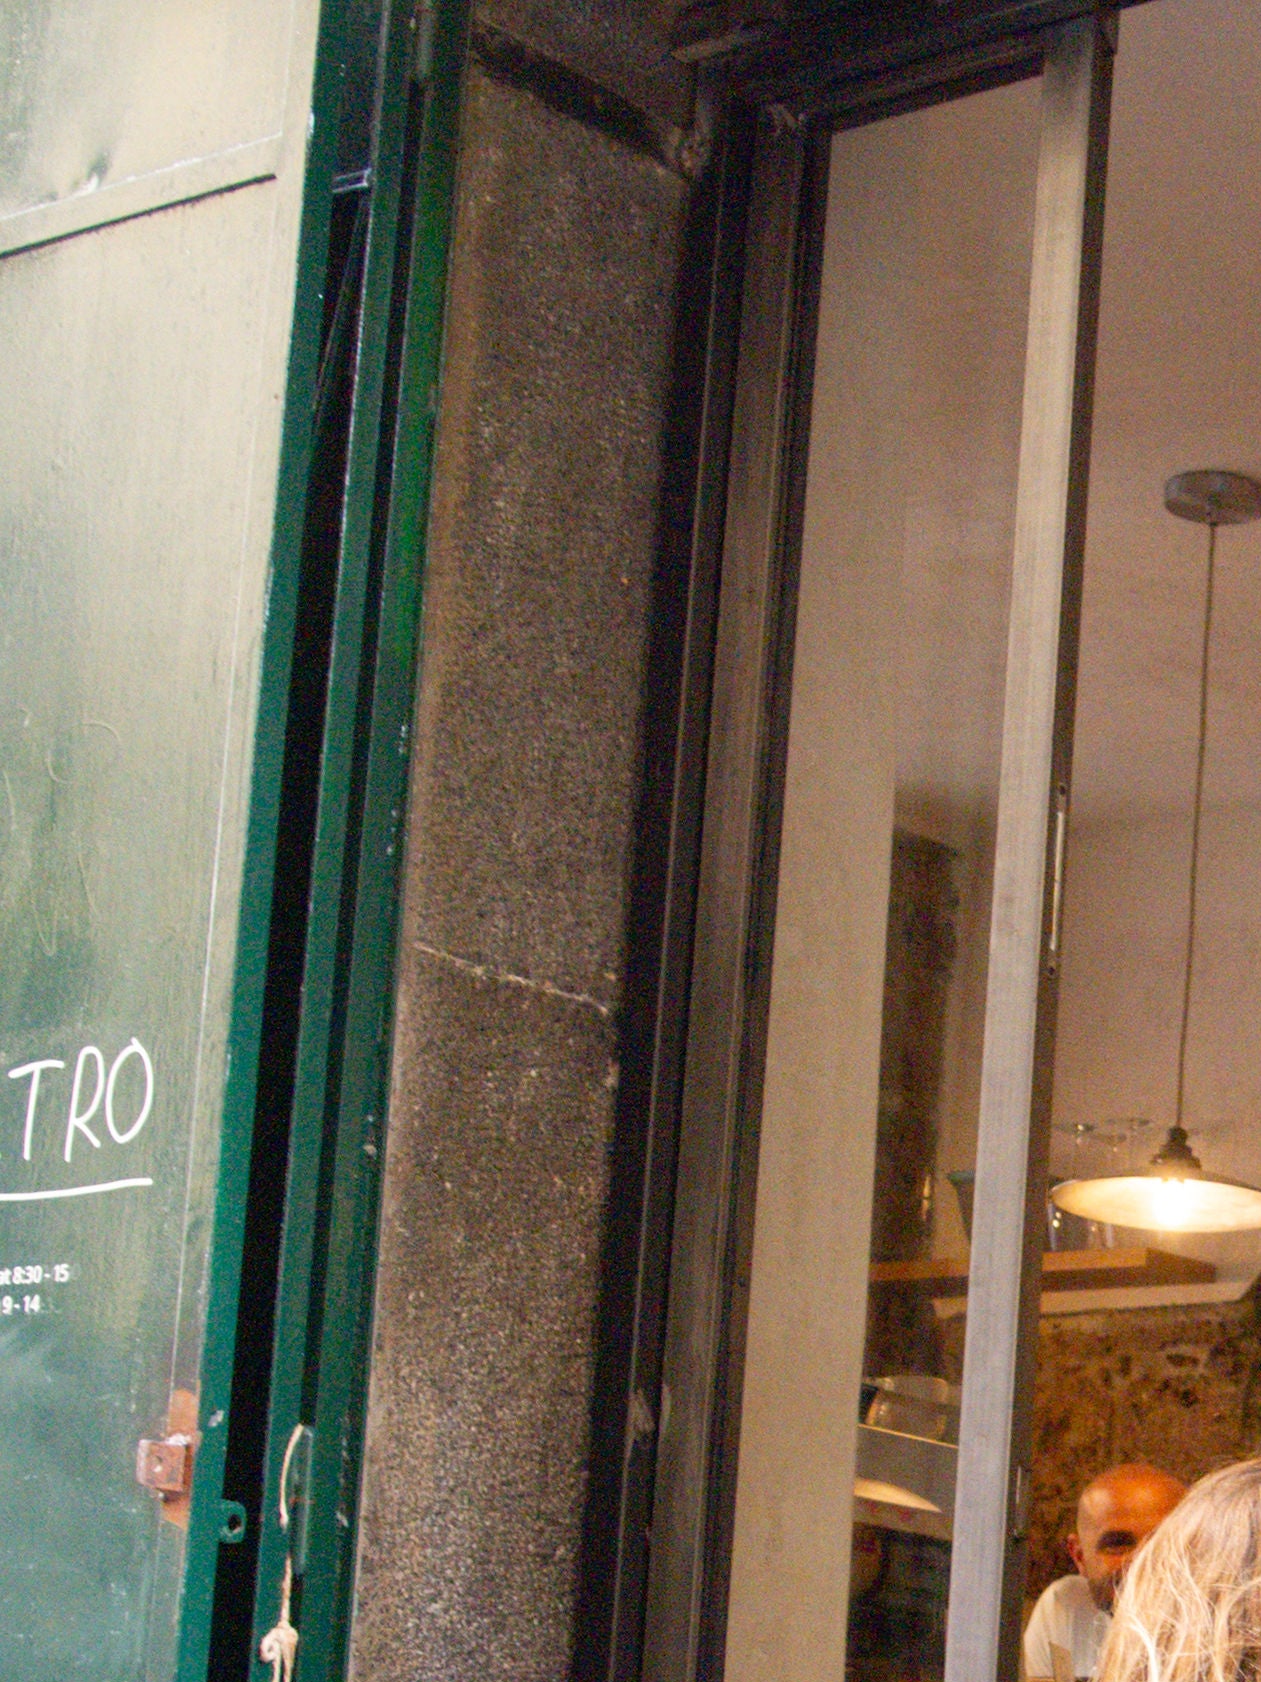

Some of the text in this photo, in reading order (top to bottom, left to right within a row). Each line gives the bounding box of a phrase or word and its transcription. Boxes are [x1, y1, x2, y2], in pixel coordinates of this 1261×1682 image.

[8, 1037, 154, 1162] TRO
[12, 1264, 43, 1285] 8:30
[54, 1263, 70, 1283] 15
[22, 1294, 41, 1313] 14
